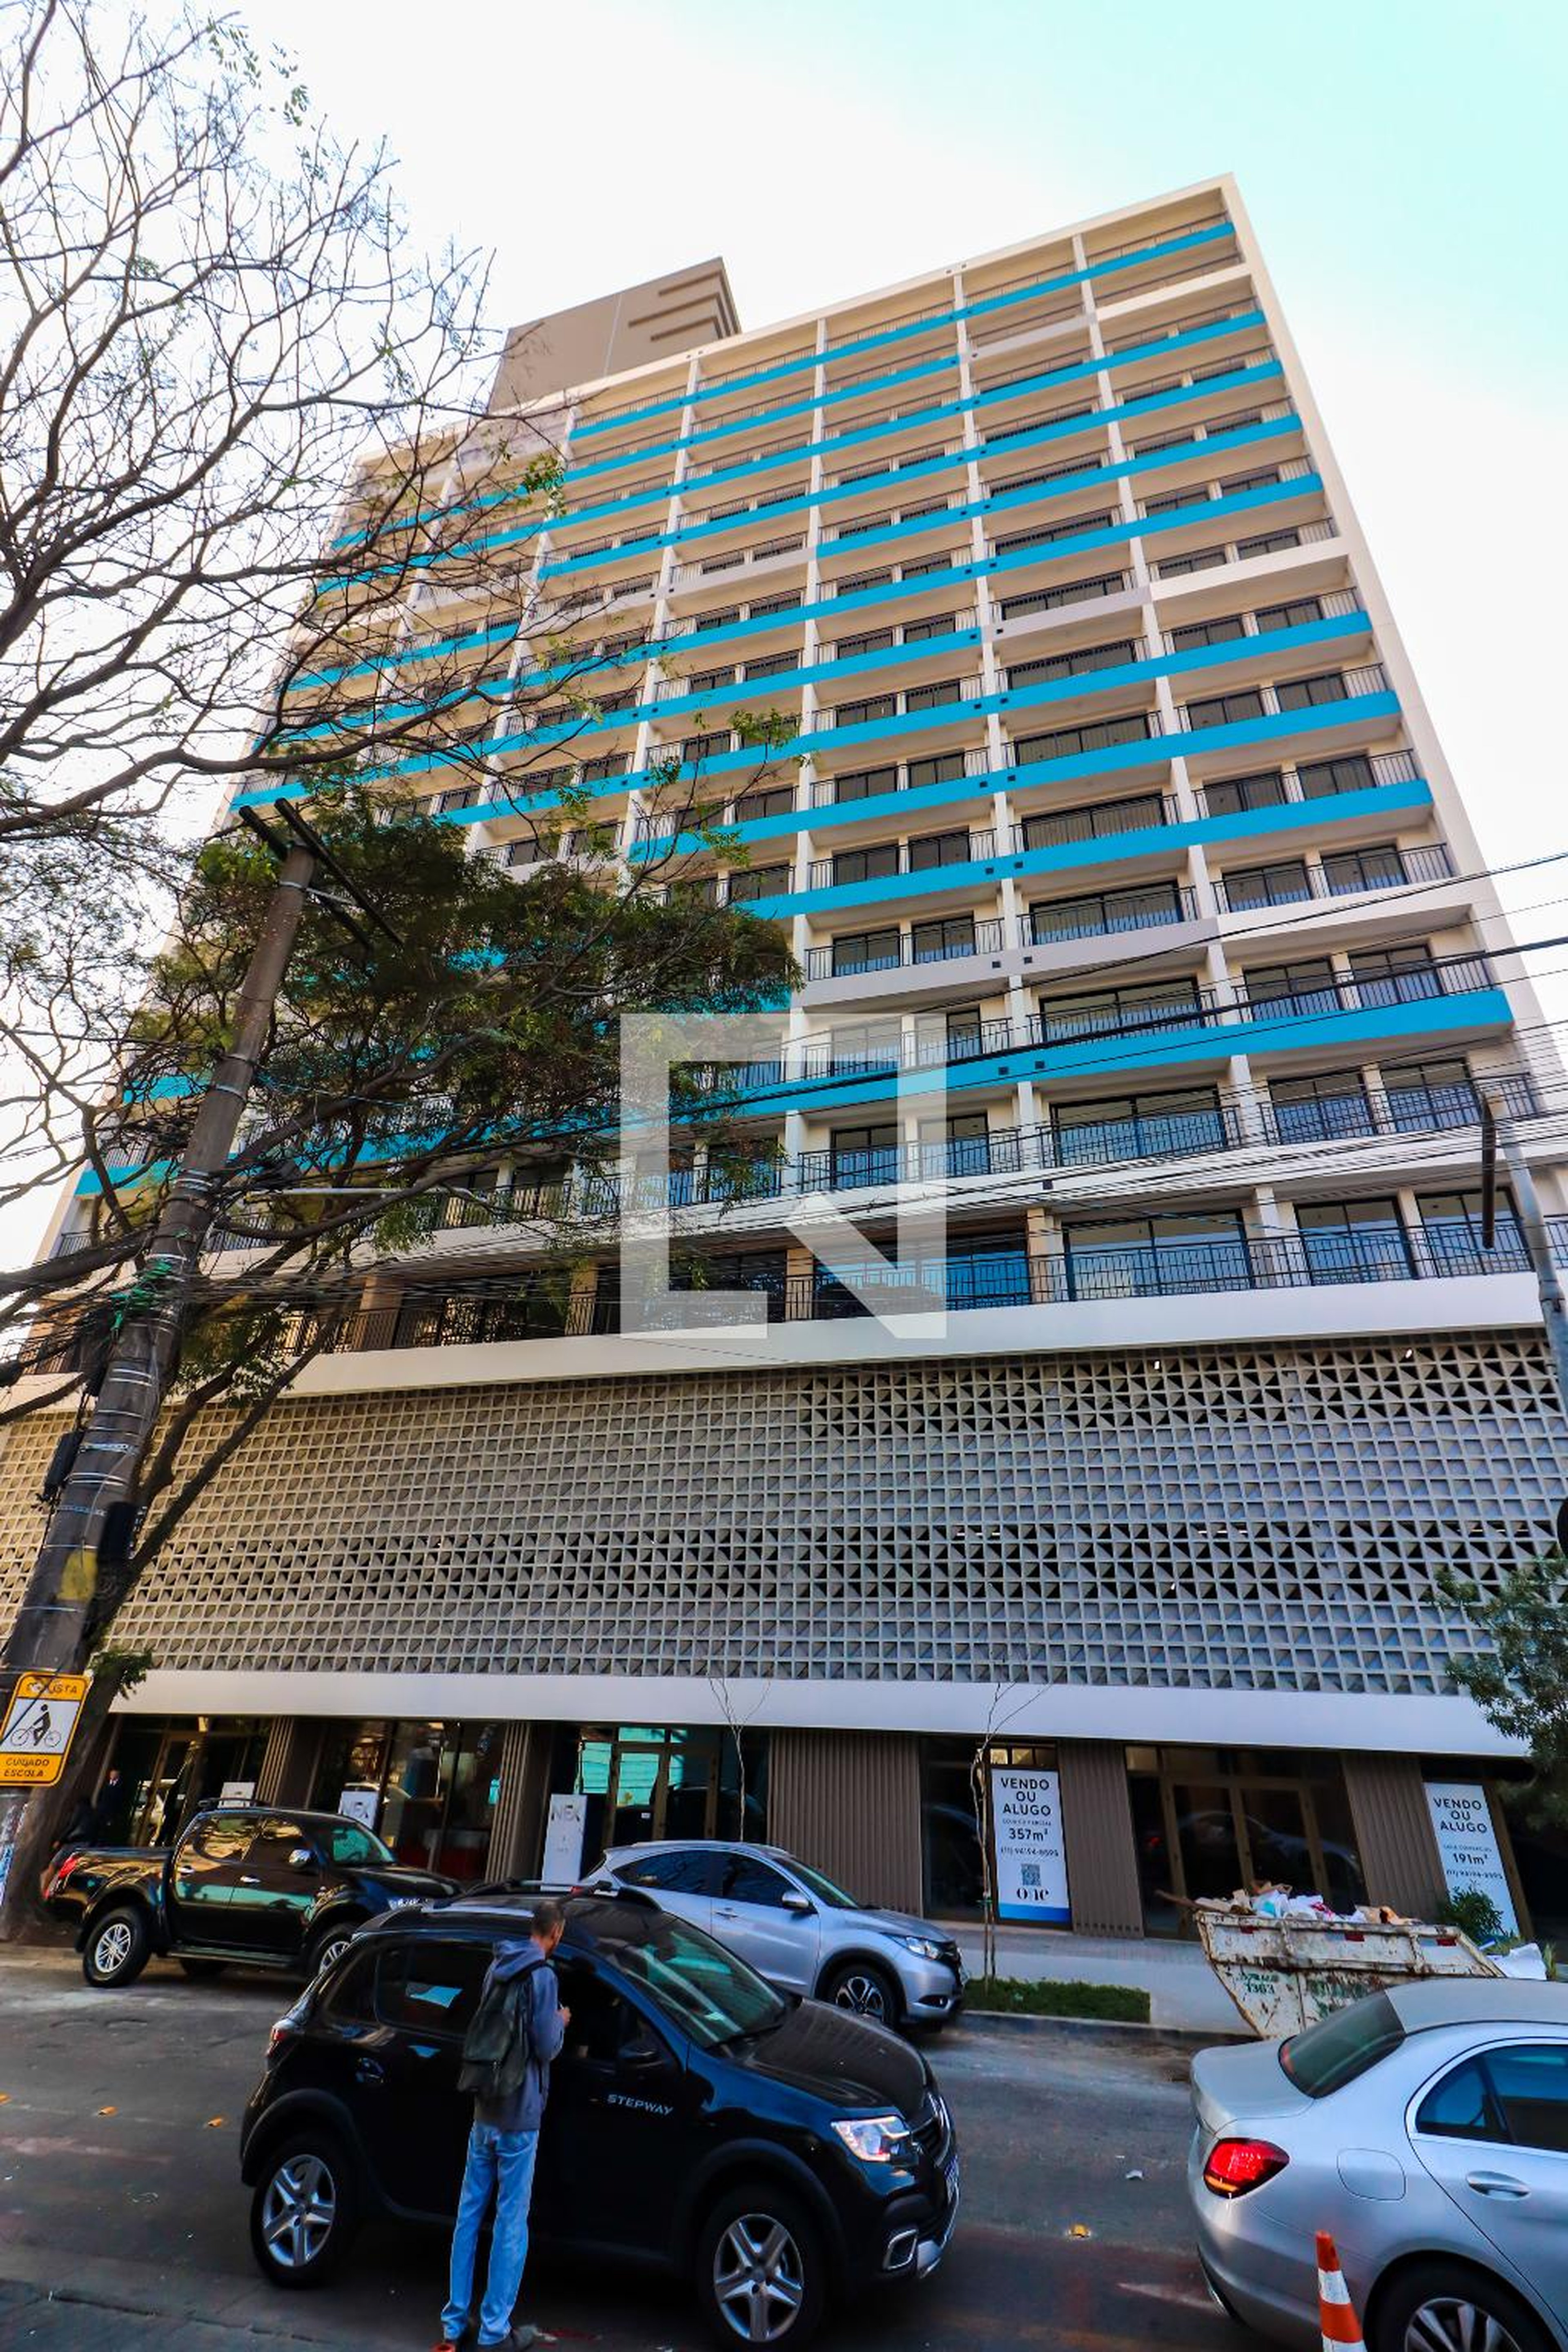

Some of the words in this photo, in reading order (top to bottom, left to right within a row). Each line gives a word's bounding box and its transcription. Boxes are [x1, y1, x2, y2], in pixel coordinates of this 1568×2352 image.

[4, 1768, 44, 1777] ESCOLA
[1001, 1777, 1049, 1790] VENDO
[1016, 1791, 1036, 1802] OU
[1003, 1803, 1051, 1816] ALUGO
[1433, 1797, 1482, 1810] VENDO
[1451, 1810, 1470, 1820] OU
[1441, 1820, 1487, 1833] ALUGO
[608, 2094, 673, 2116] STEPWAY
